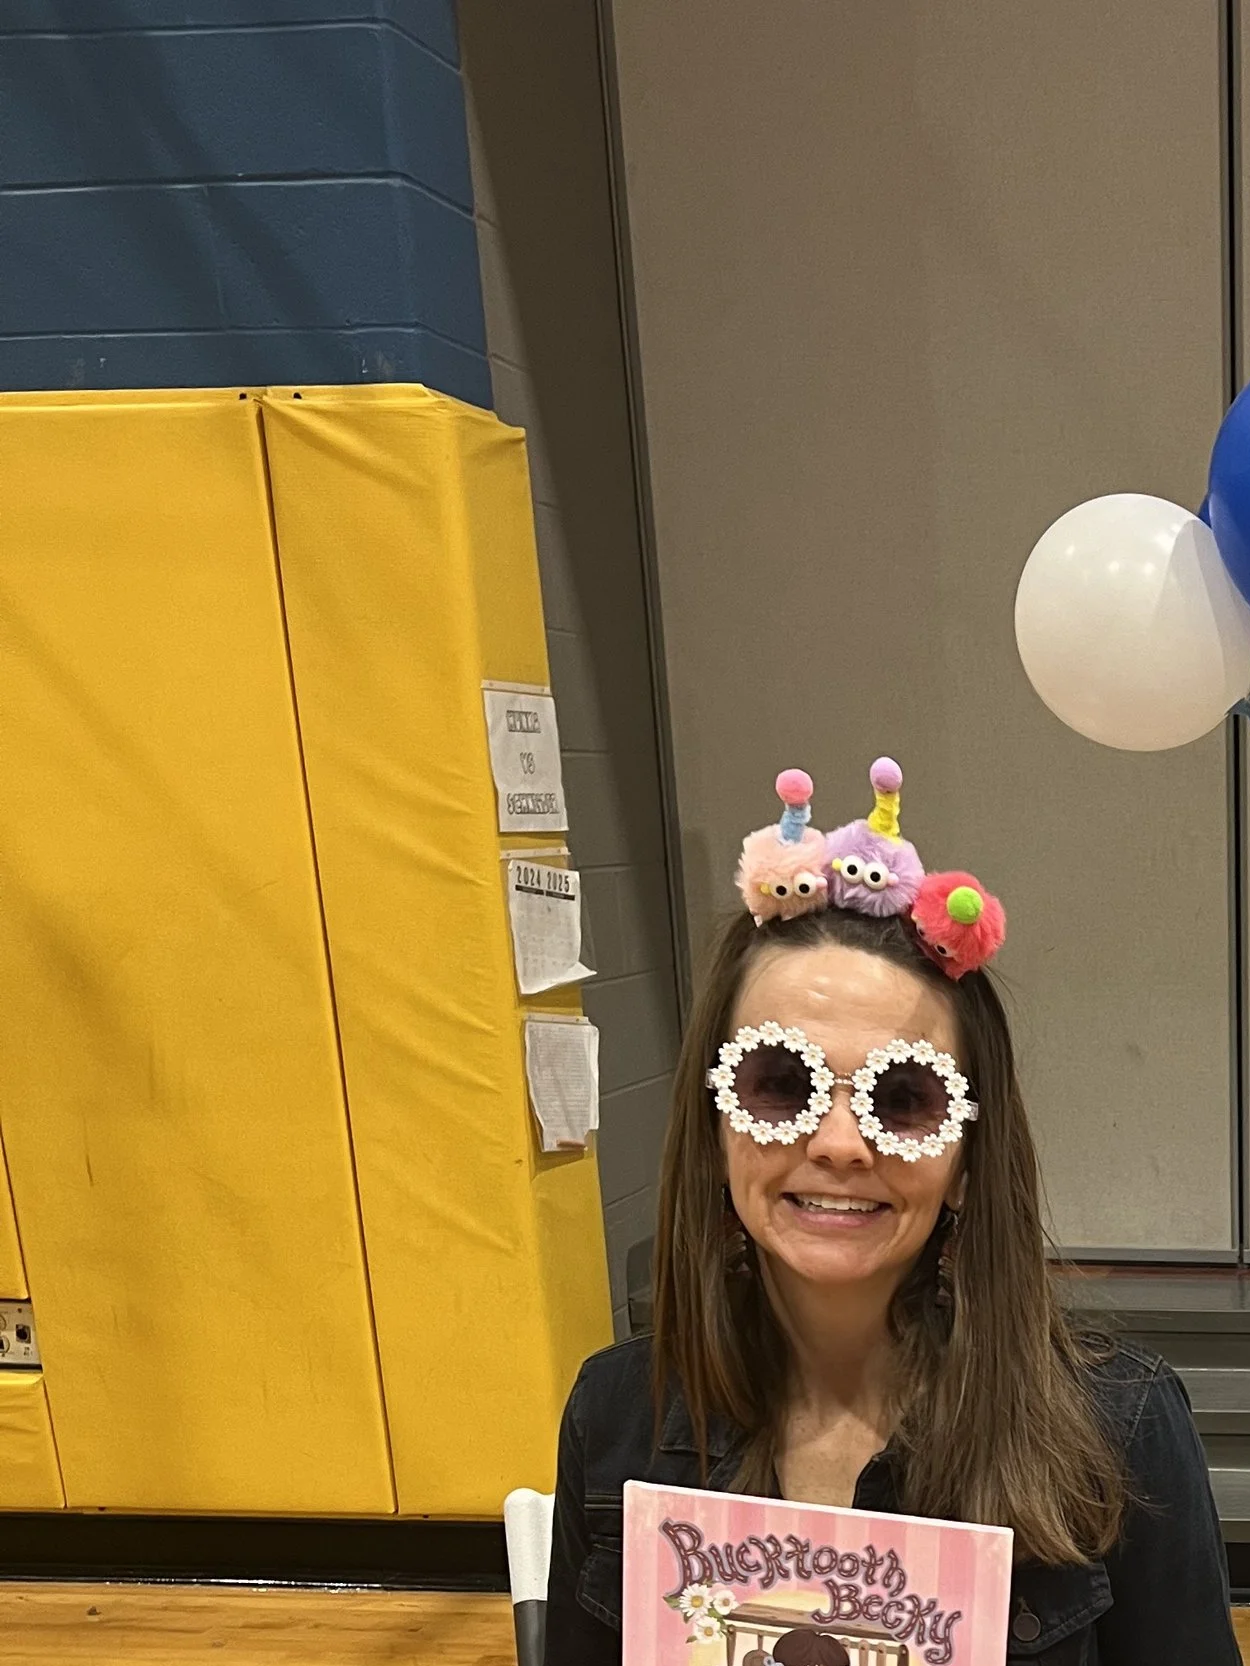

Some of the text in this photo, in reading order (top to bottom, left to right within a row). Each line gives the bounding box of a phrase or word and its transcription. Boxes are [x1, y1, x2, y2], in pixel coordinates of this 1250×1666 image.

[516, 866, 541, 888] 2024
[547, 871, 570, 893] 2025
[659, 1517, 907, 1598] Bucktooth
[812, 1578, 963, 1666] Becky
